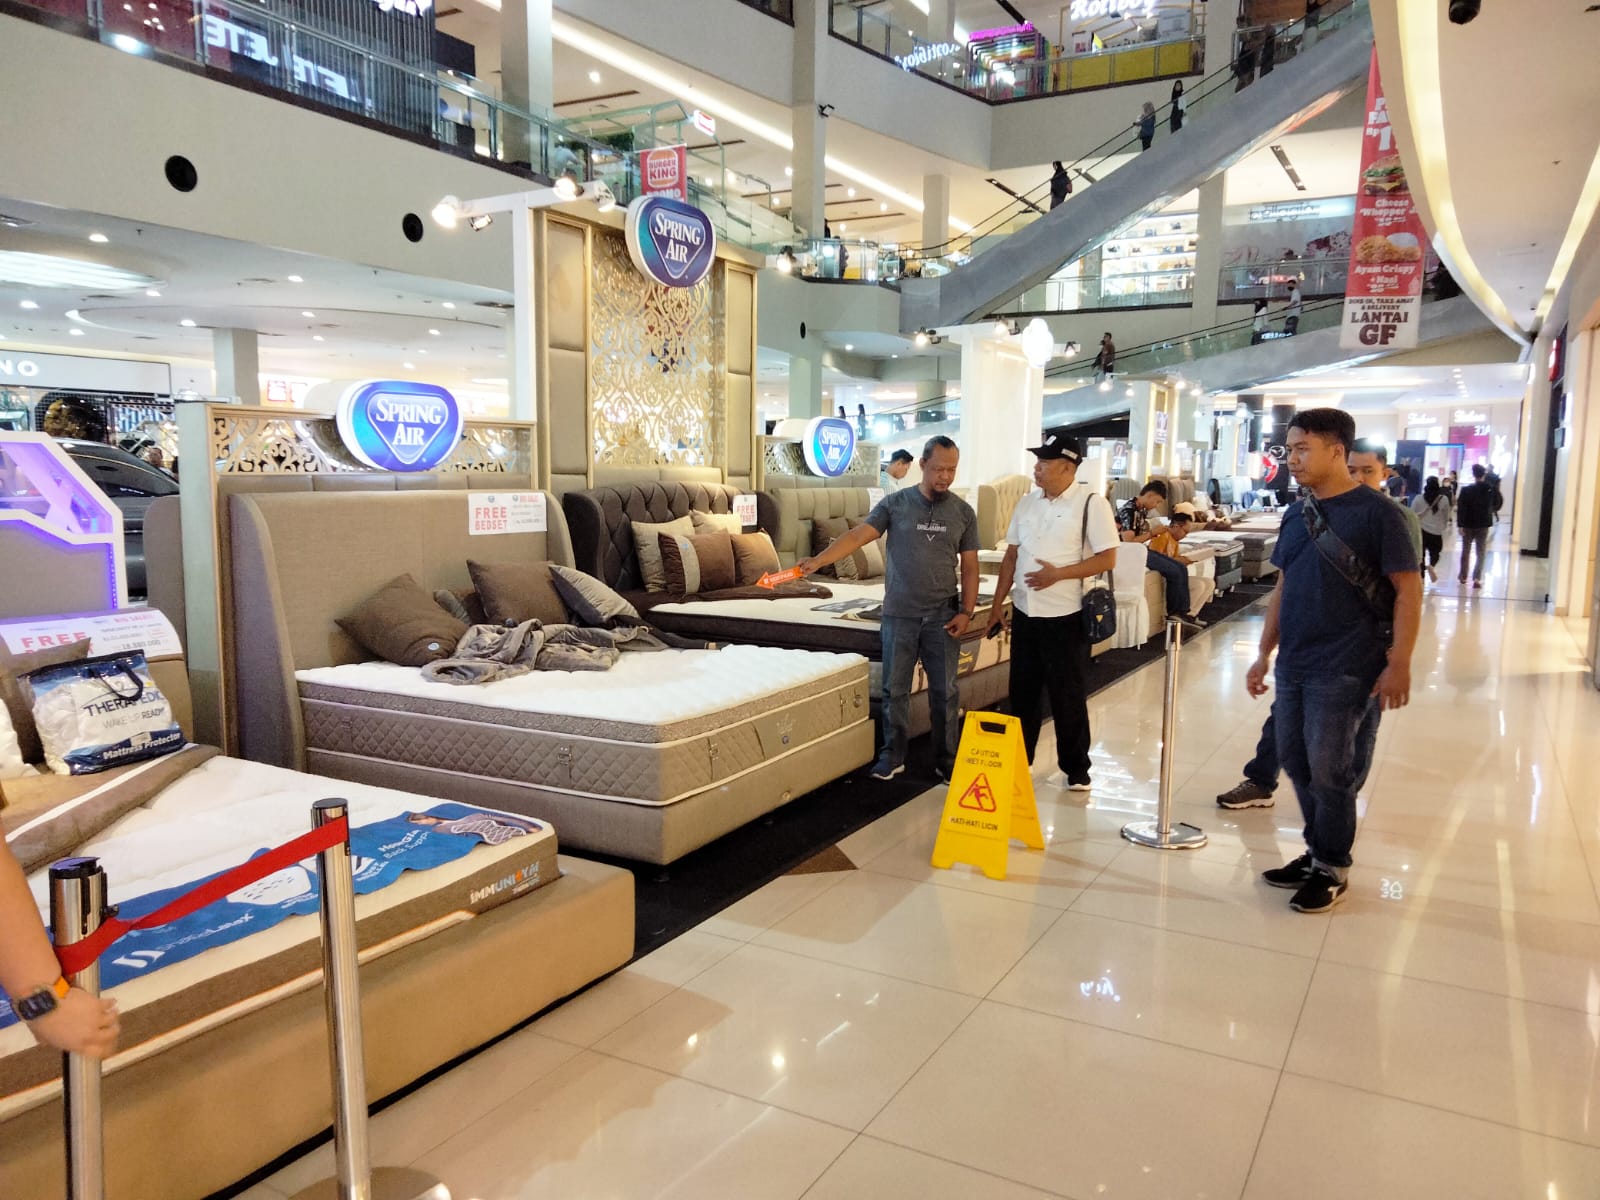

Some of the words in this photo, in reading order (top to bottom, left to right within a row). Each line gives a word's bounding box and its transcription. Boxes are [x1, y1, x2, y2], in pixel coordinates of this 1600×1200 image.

[649, 167, 677, 180] KING
[654, 212, 701, 246] SPRING
[665, 238, 688, 264] AIR
[1382, 264, 1416, 275] Crispy
[1350, 311, 1409, 323] LANTAI
[1358, 323, 1398, 346] GF
[375, 398, 443, 424] SPRING
[392, 423, 425, 446] AIR
[822, 430, 848, 447] SPRING
[826, 444, 841, 460] AIR
[475, 506, 508, 519] FREE
[736, 504, 755, 514] FREE
[474, 519, 508, 531] BEDSET
[21, 631, 88, 649] FREE
[103, 716, 129, 730] WAKE
[103, 744, 144, 760] Mattress
[144, 731, 181, 748] Protector
[970, 748, 1000, 758] CAUTION
[980, 759, 1002, 768] FLOOR
[951, 817, 980, 828] HATI-HATI
[981, 821, 998, 831] LICIN
